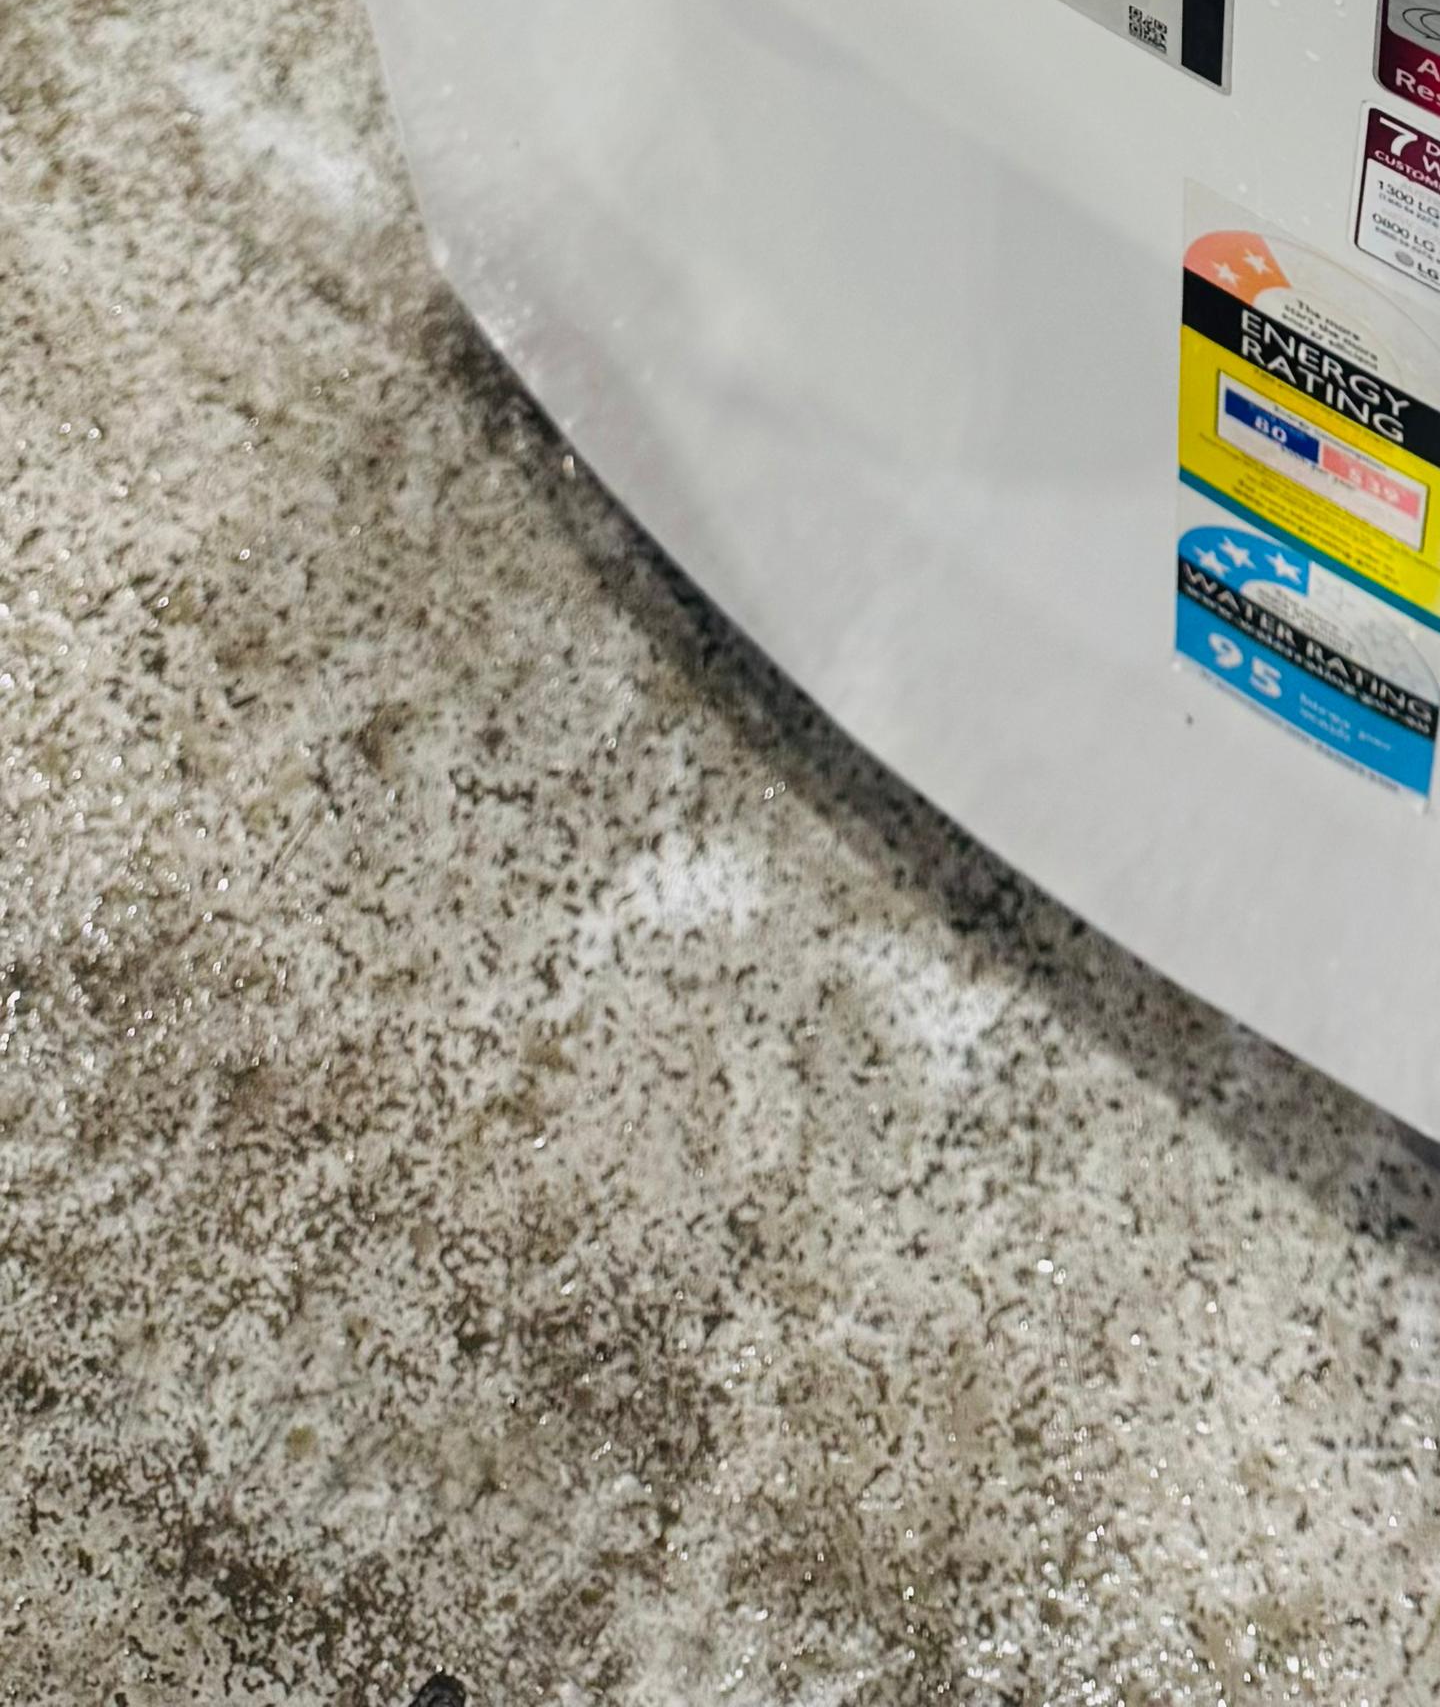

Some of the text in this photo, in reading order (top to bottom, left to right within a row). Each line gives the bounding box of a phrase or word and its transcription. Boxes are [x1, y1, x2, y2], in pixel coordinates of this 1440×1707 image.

[1380, 116, 1418, 157] 7
[1378, 180, 1414, 205] 1300
[1418, 201, 1440, 219] LG
[1413, 235, 1435, 253] LG
[1417, 262, 1439, 280] LG
[1242, 309, 1411, 417] ENERGY
[1242, 334, 1404, 443] RATING
[1254, 415, 1288, 443] 80
[1183, 563, 1296, 647] WATER
[1305, 641, 1432, 723] RATING
[1208, 632, 1282, 699] 95
